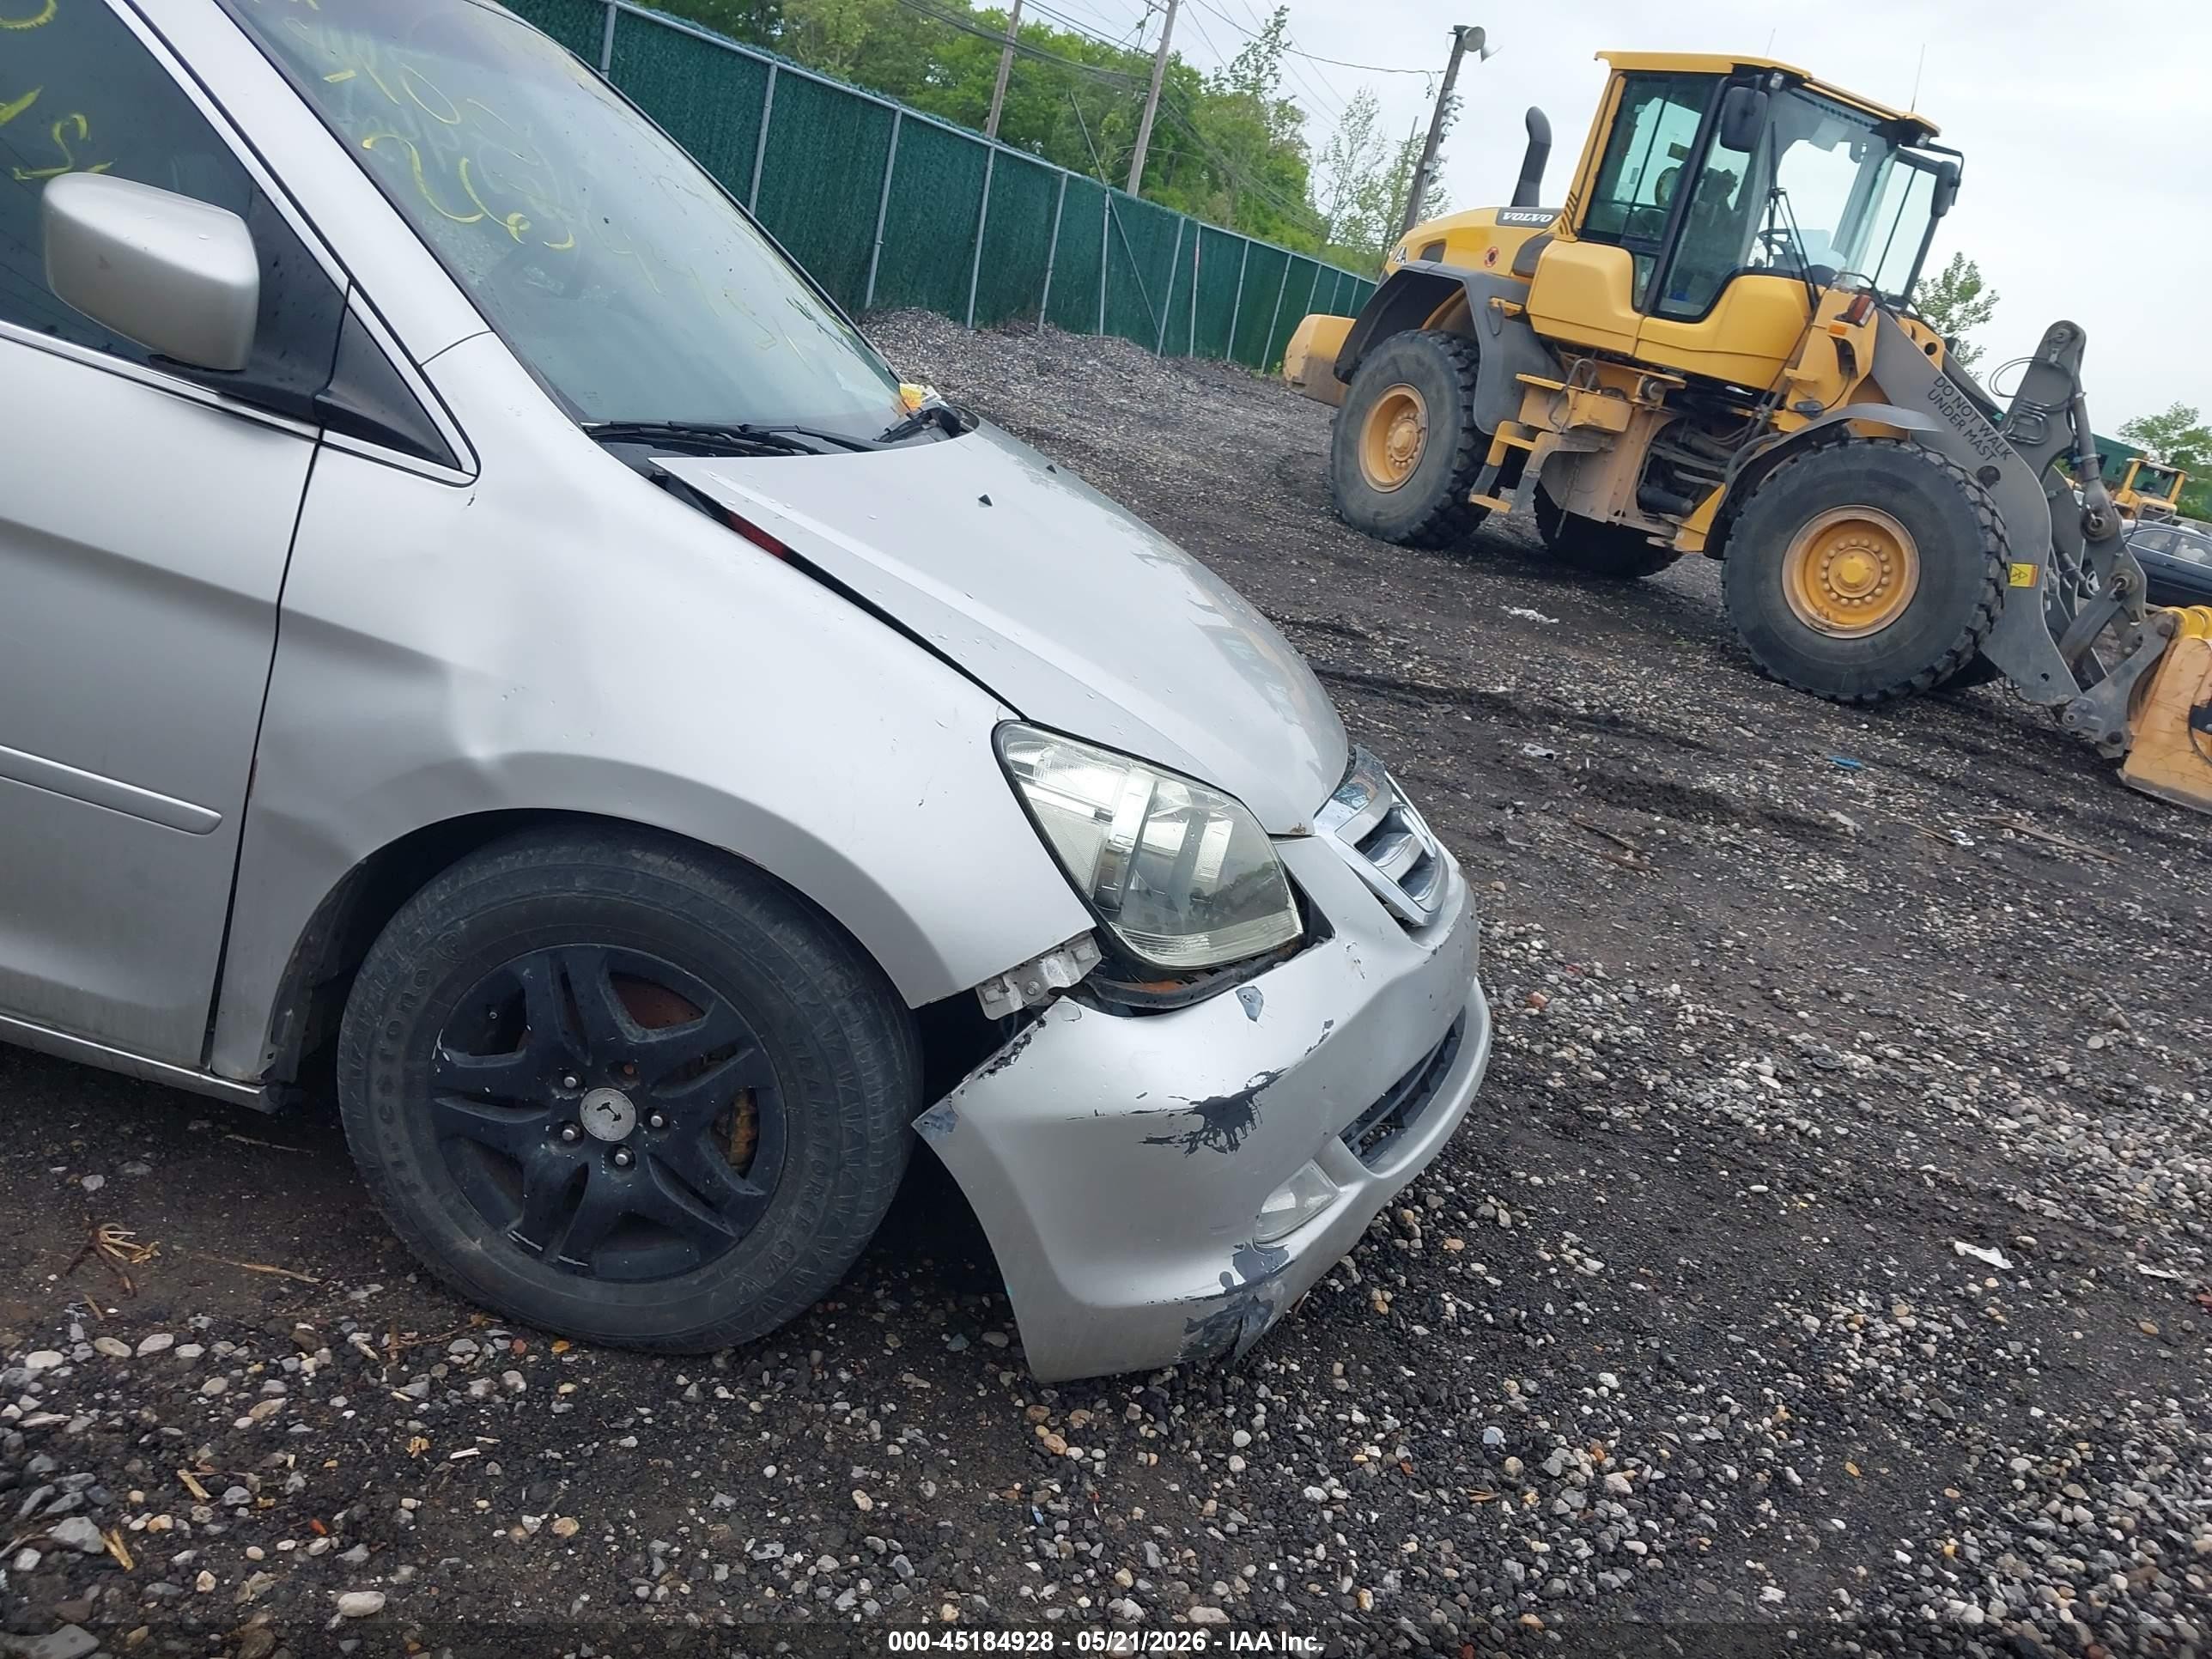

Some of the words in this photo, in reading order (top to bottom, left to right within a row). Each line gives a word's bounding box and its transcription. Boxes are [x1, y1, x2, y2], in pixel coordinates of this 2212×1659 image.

[1503, 211, 1554, 222] VOLVO
[1927, 388, 1966, 431] UNDER
[1963, 428, 1997, 461] MAST
[1933, 376, 1954, 397] DO
[1952, 395, 1982, 423] NOT
[1978, 424, 2013, 460] WALK
